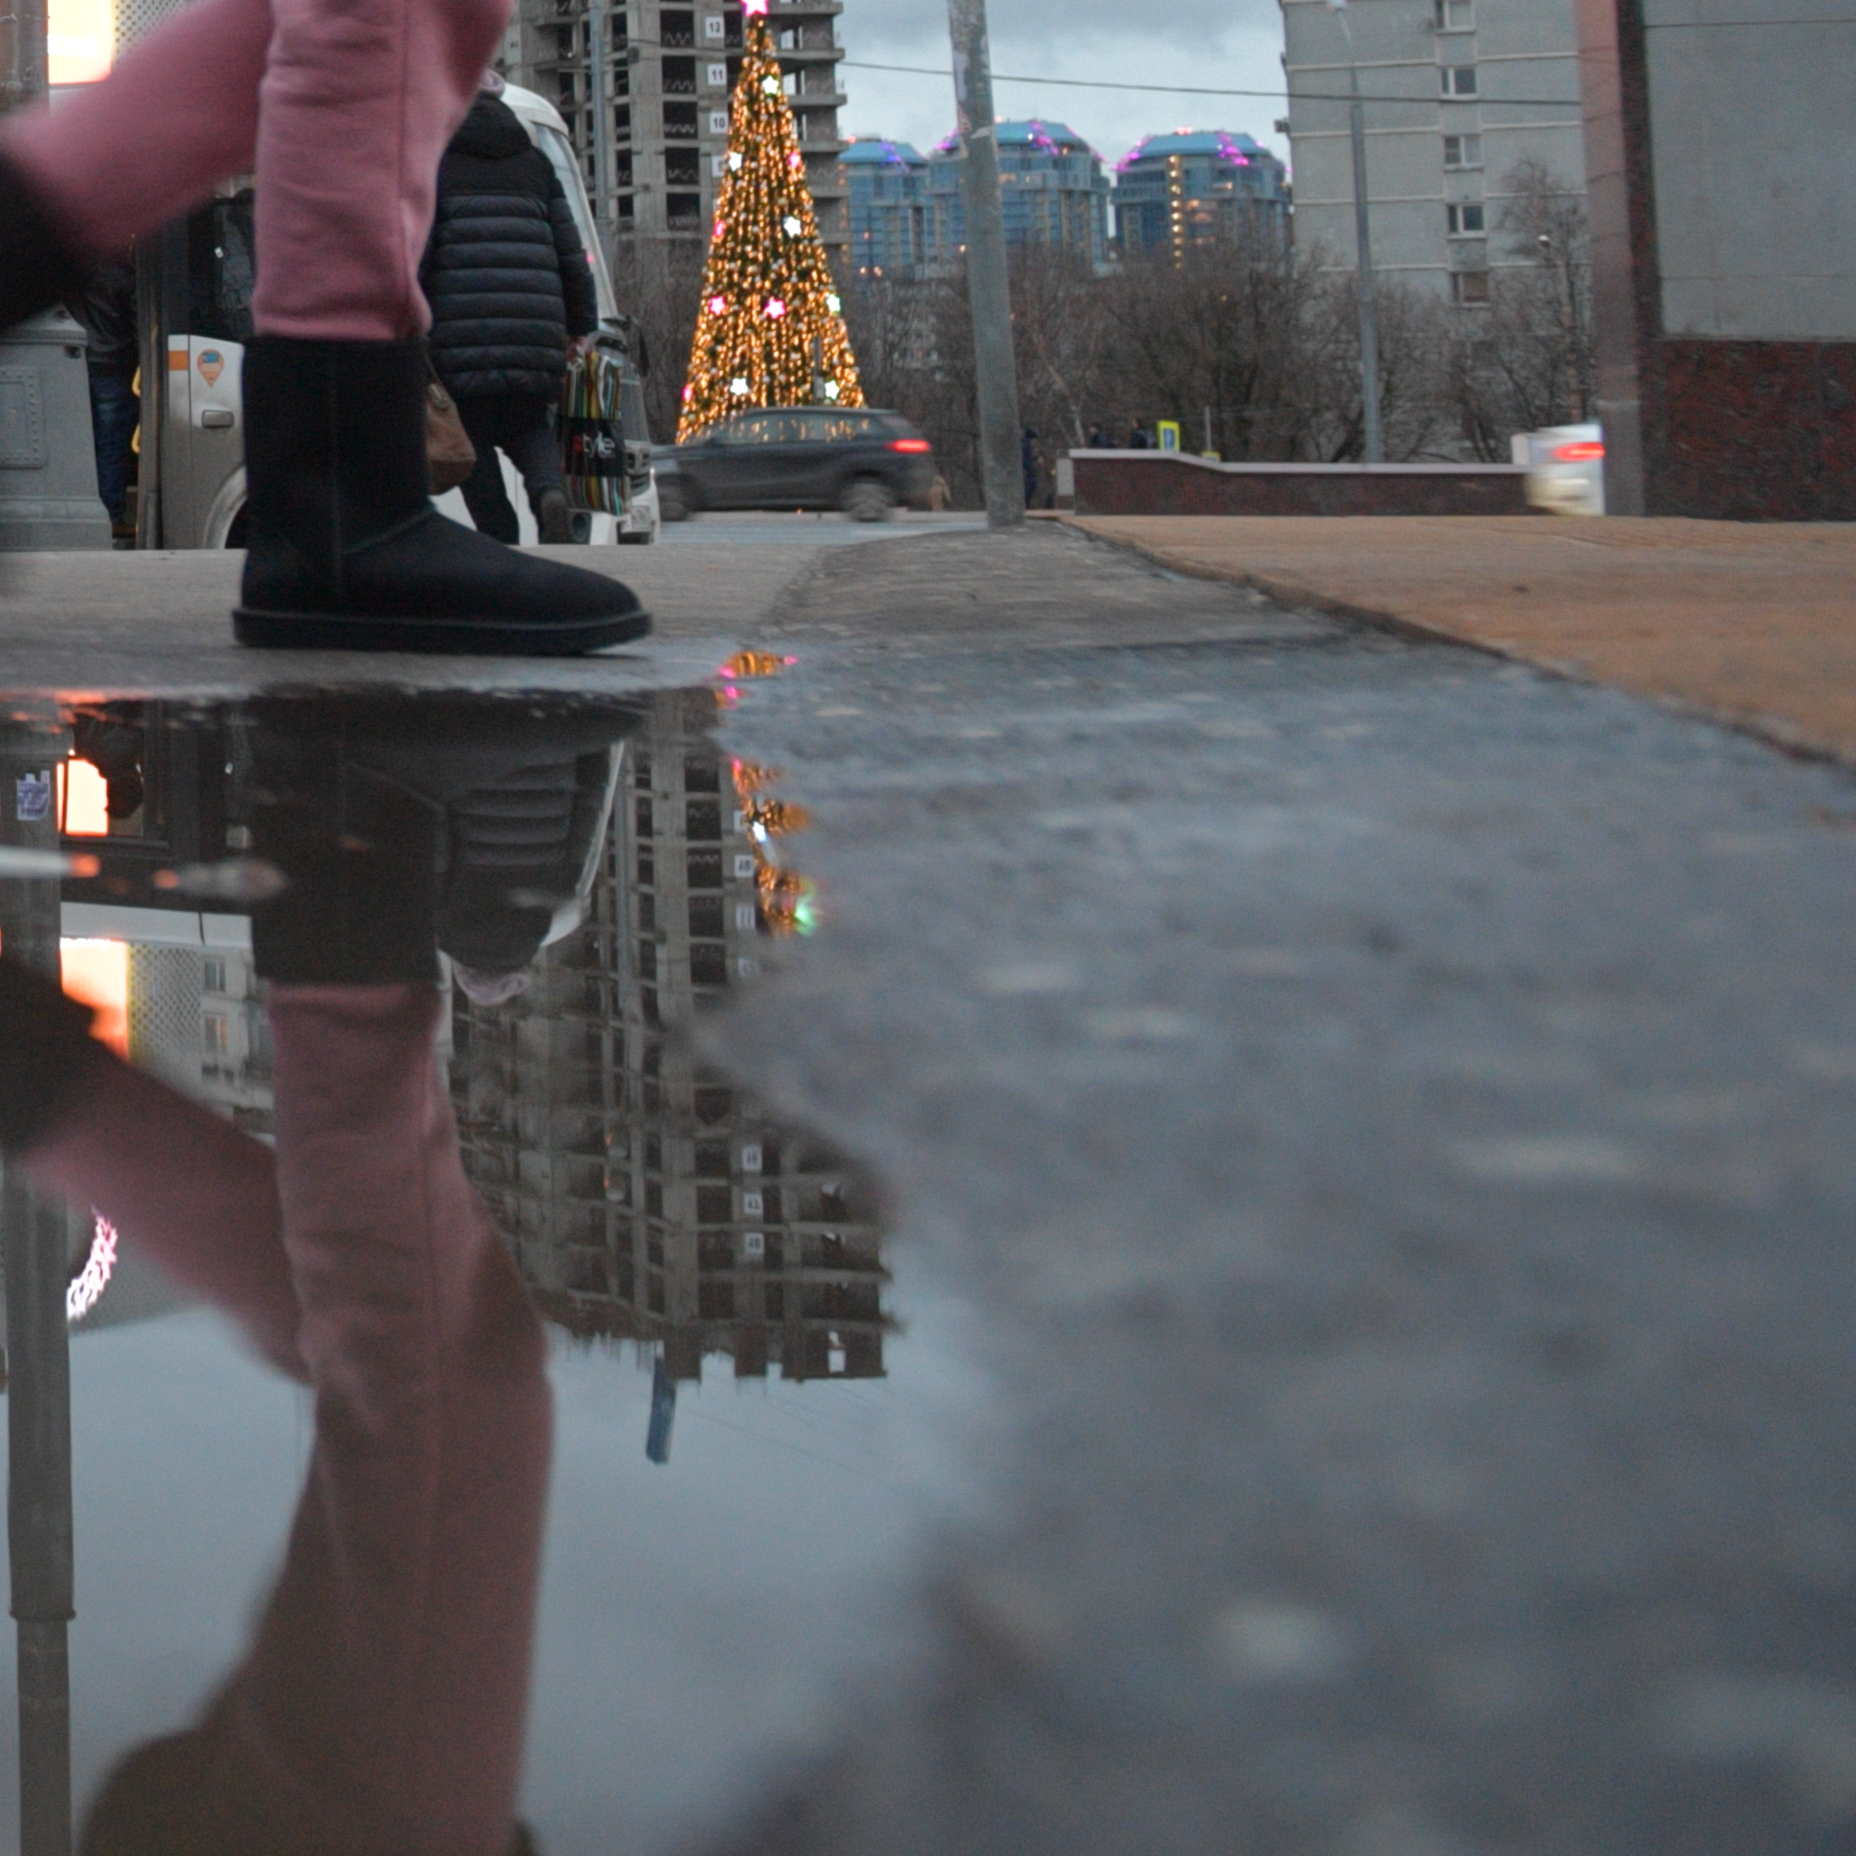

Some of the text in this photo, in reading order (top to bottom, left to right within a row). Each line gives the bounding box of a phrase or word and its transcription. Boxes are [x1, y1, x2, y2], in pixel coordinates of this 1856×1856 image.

[709, 21, 721, 34] 12
[711, 68, 723, 81] 11
[713, 116, 725, 129] 10
